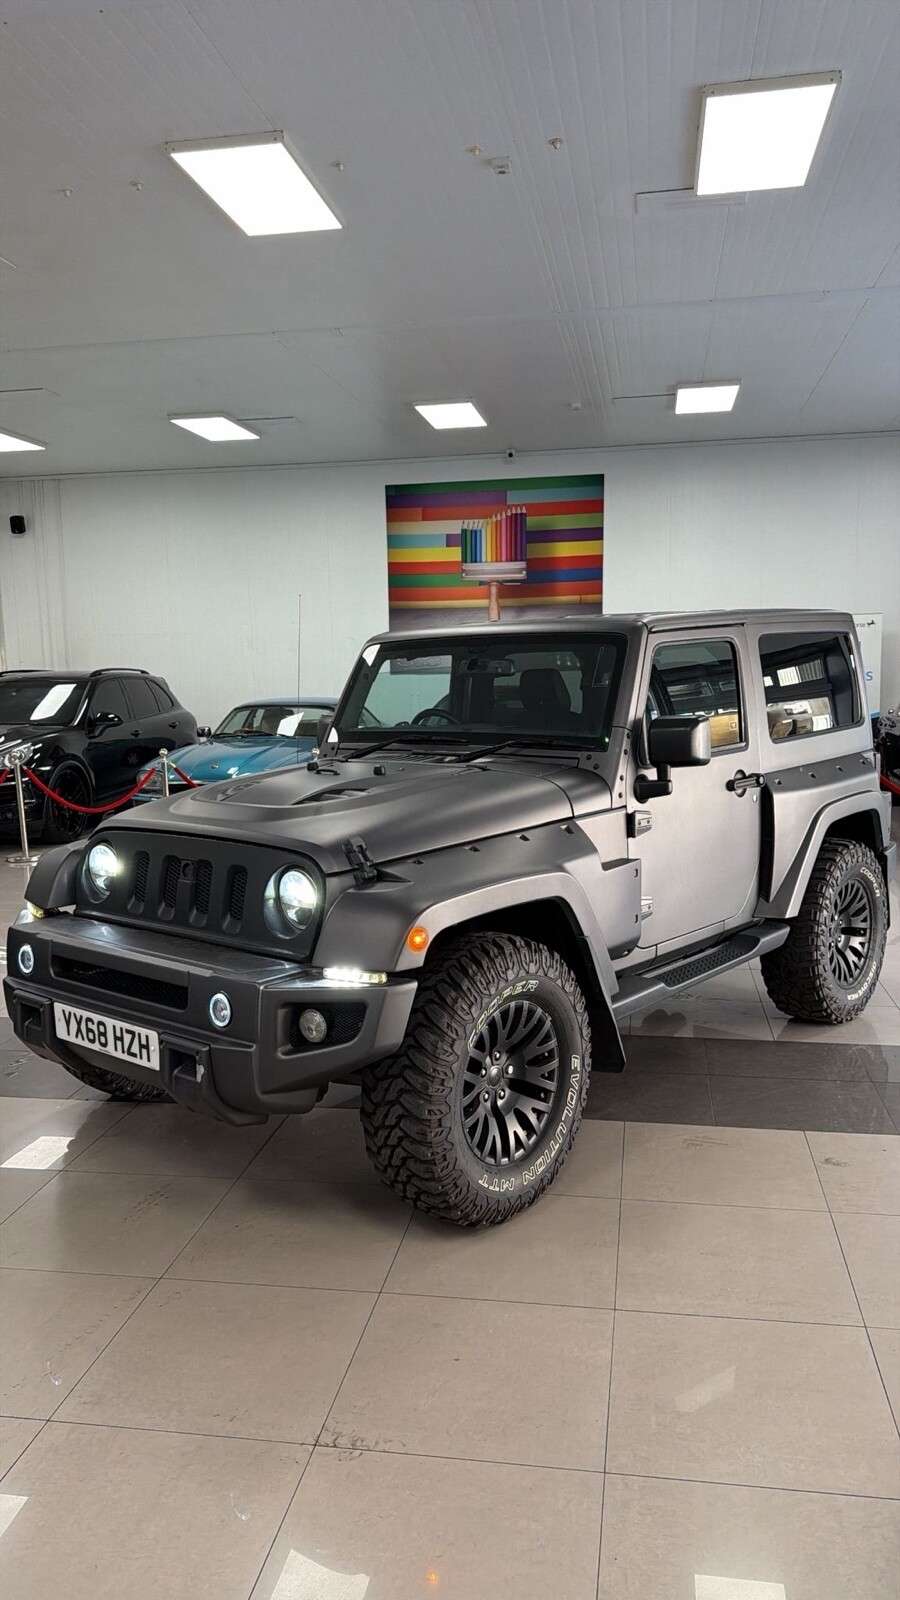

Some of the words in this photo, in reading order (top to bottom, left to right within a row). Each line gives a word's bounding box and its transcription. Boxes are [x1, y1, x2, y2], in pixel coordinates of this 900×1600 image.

[860, 867, 880, 897] COOPER
[62, 1009, 108, 1048] YX68
[113, 1024, 151, 1062] HZH
[468, 979, 539, 1049] COOPER
[522, 1054, 581, 1185] EVOLUTION
[478, 1174, 515, 1192] MTT
